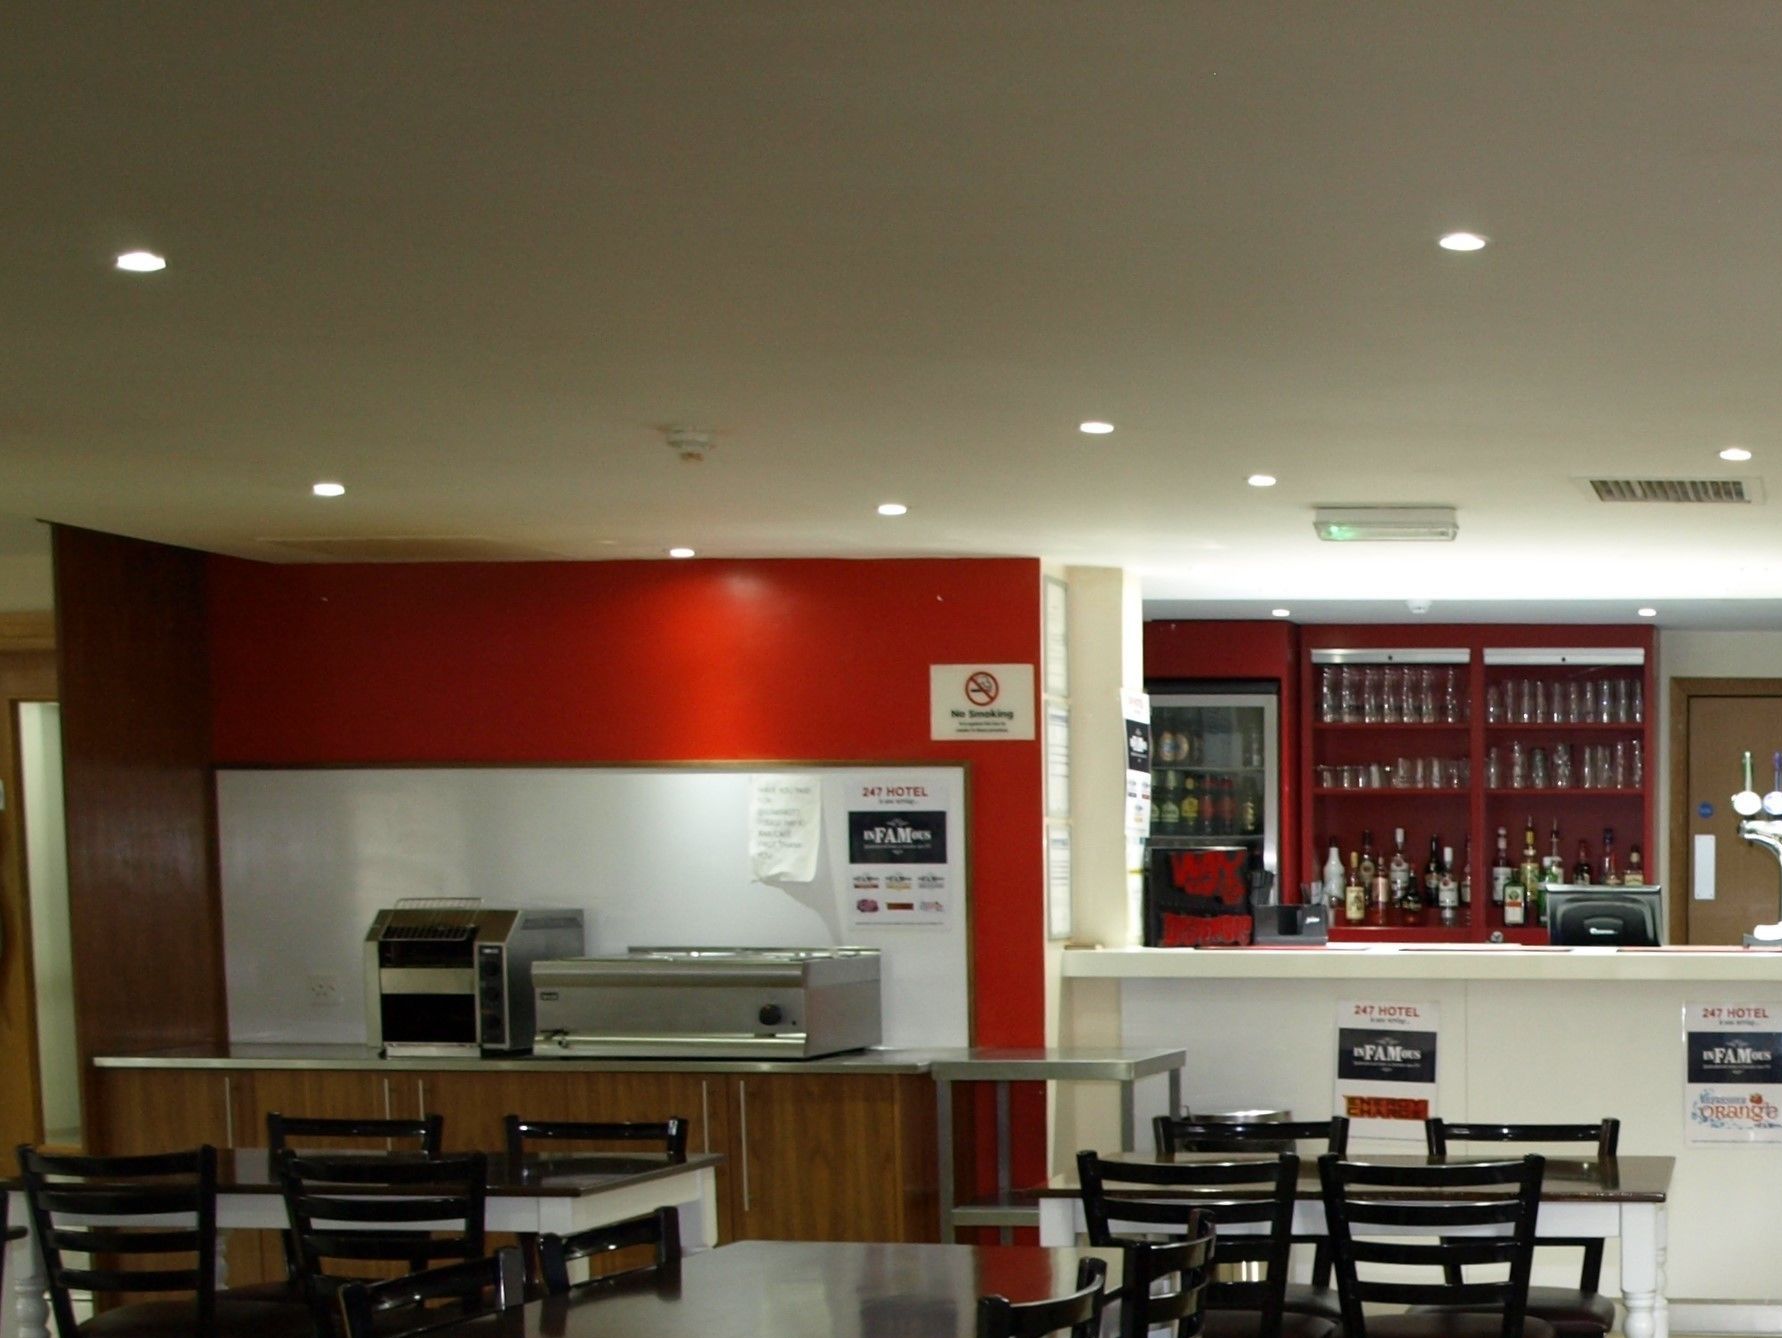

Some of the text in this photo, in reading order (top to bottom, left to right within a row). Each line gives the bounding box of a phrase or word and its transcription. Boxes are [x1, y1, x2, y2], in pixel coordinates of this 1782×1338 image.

[951, 709, 1014, 720] No Smoking
[862, 787, 928, 797] 247 HOTEL
[1354, 1005, 1420, 1017] 247 HOTEL
[1702, 1008, 1769, 1019] 247 HOTEL
